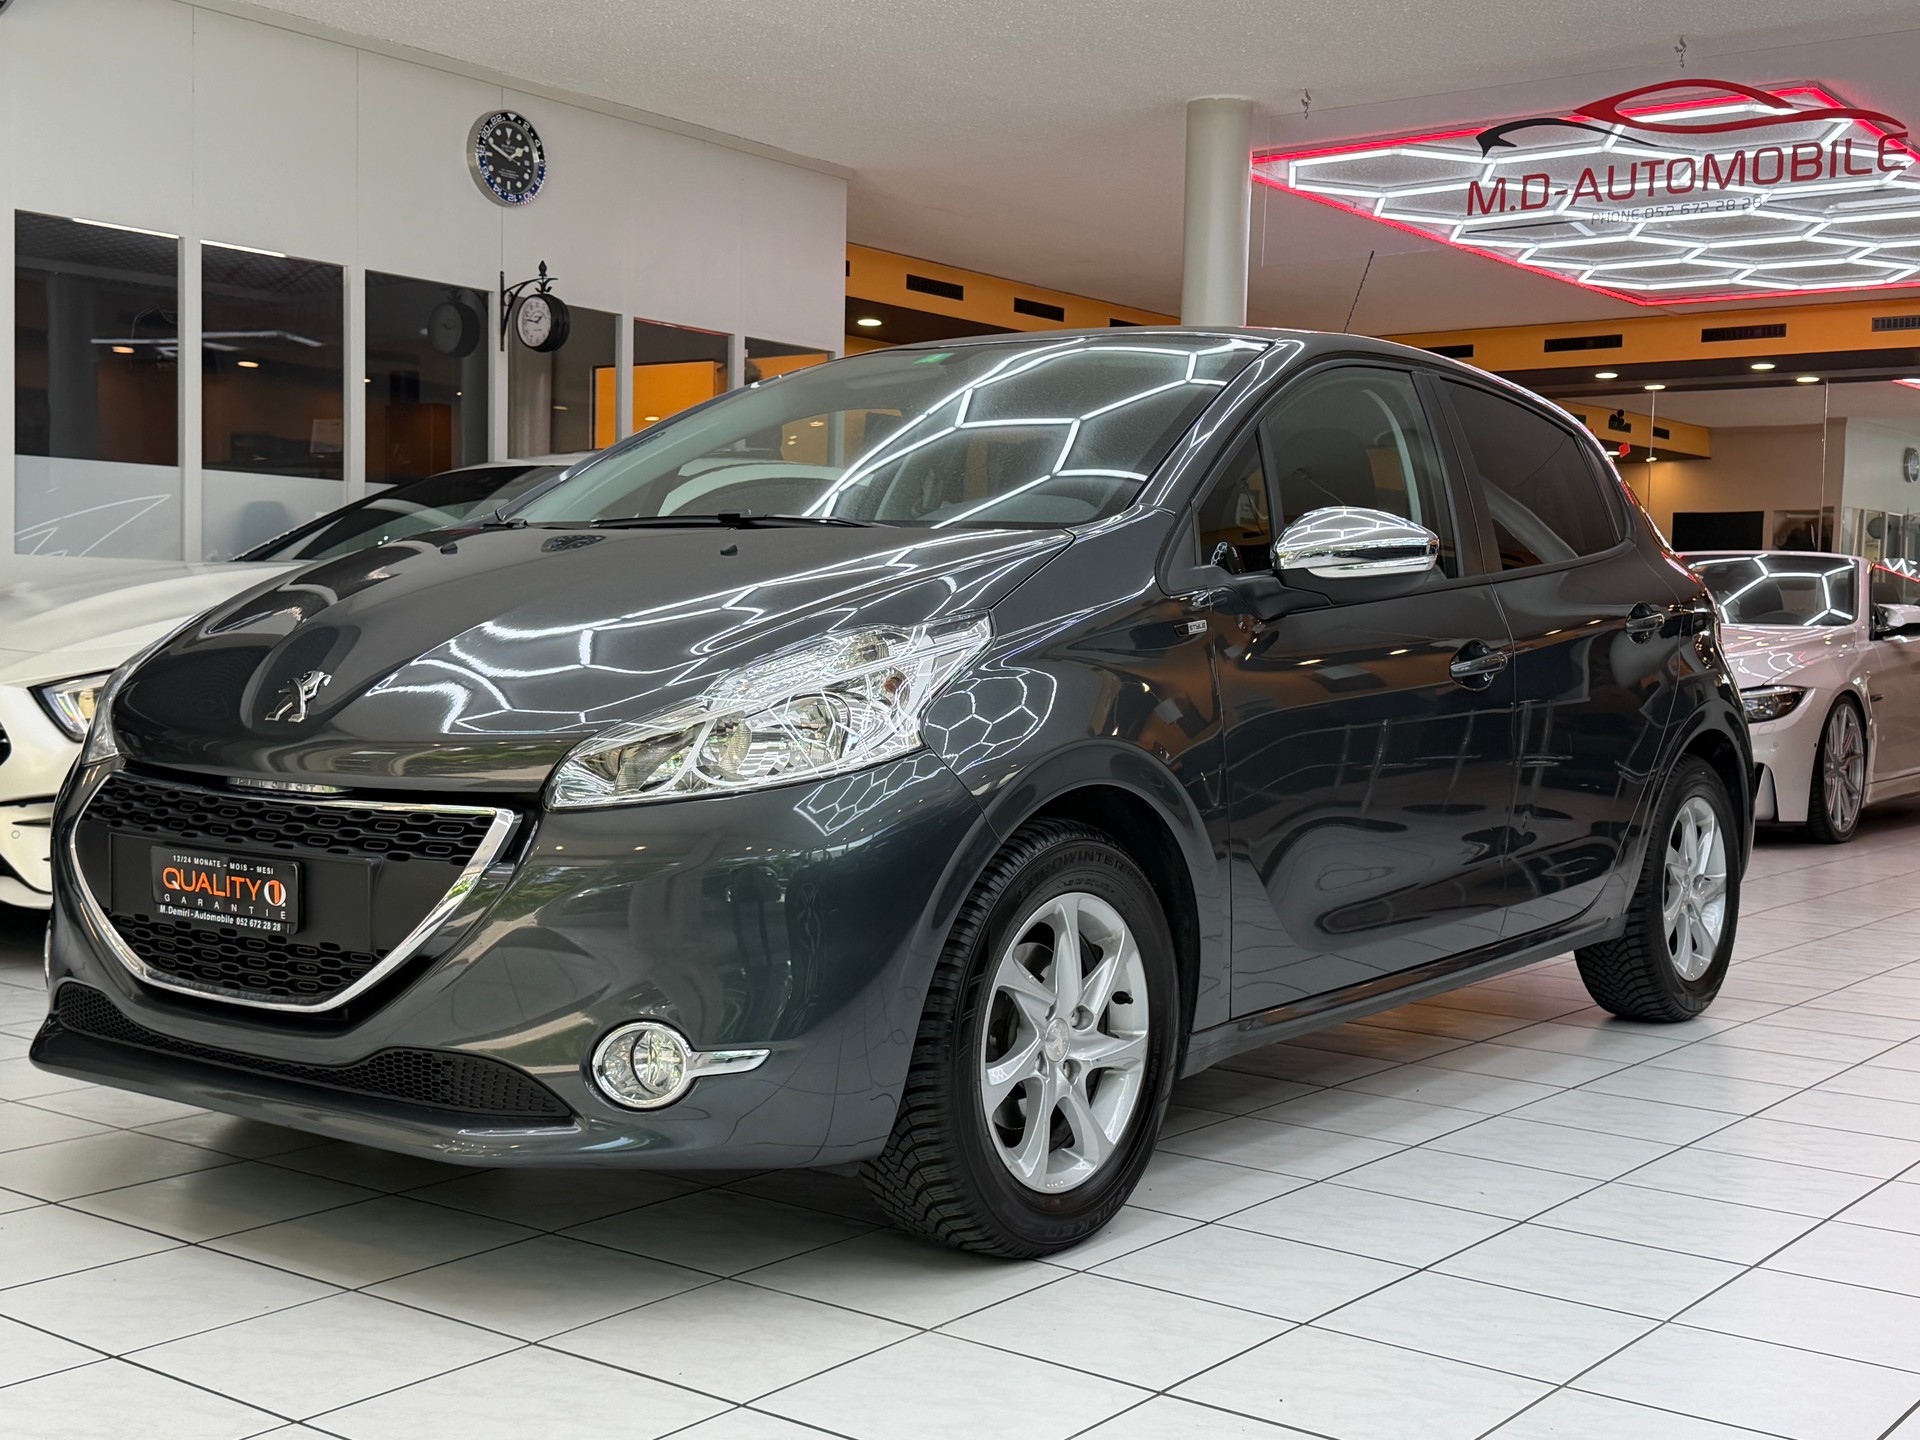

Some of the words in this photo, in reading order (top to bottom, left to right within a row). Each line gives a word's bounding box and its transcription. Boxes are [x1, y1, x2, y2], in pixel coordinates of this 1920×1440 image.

[491, 114, 502, 125] 22
[481, 125, 491, 140] 20
[1467, 132, 1909, 216] M.D-AUTOMOBILE
[1590, 208, 1640, 224] PHONE
[1644, 205, 1675, 219] 052
[1680, 202, 1710, 215] 672
[1715, 198, 1737, 213] 28
[1742, 195, 1763, 210] 28
[1190, 622, 1205, 631] STYLE
[173, 855, 192, 864] 12/24
[193, 857, 221, 868] MONATE
[229, 862, 248, 871] MOIS
[256, 867, 274, 875] MESI
[162, 867, 262, 901] QUALITY
[164, 893, 286, 920] GARANTIE
[236, 916, 248, 927] 052
[250, 919, 261, 929] 672
[262, 921, 271, 930] 28
[272, 922, 281, 932] 28
